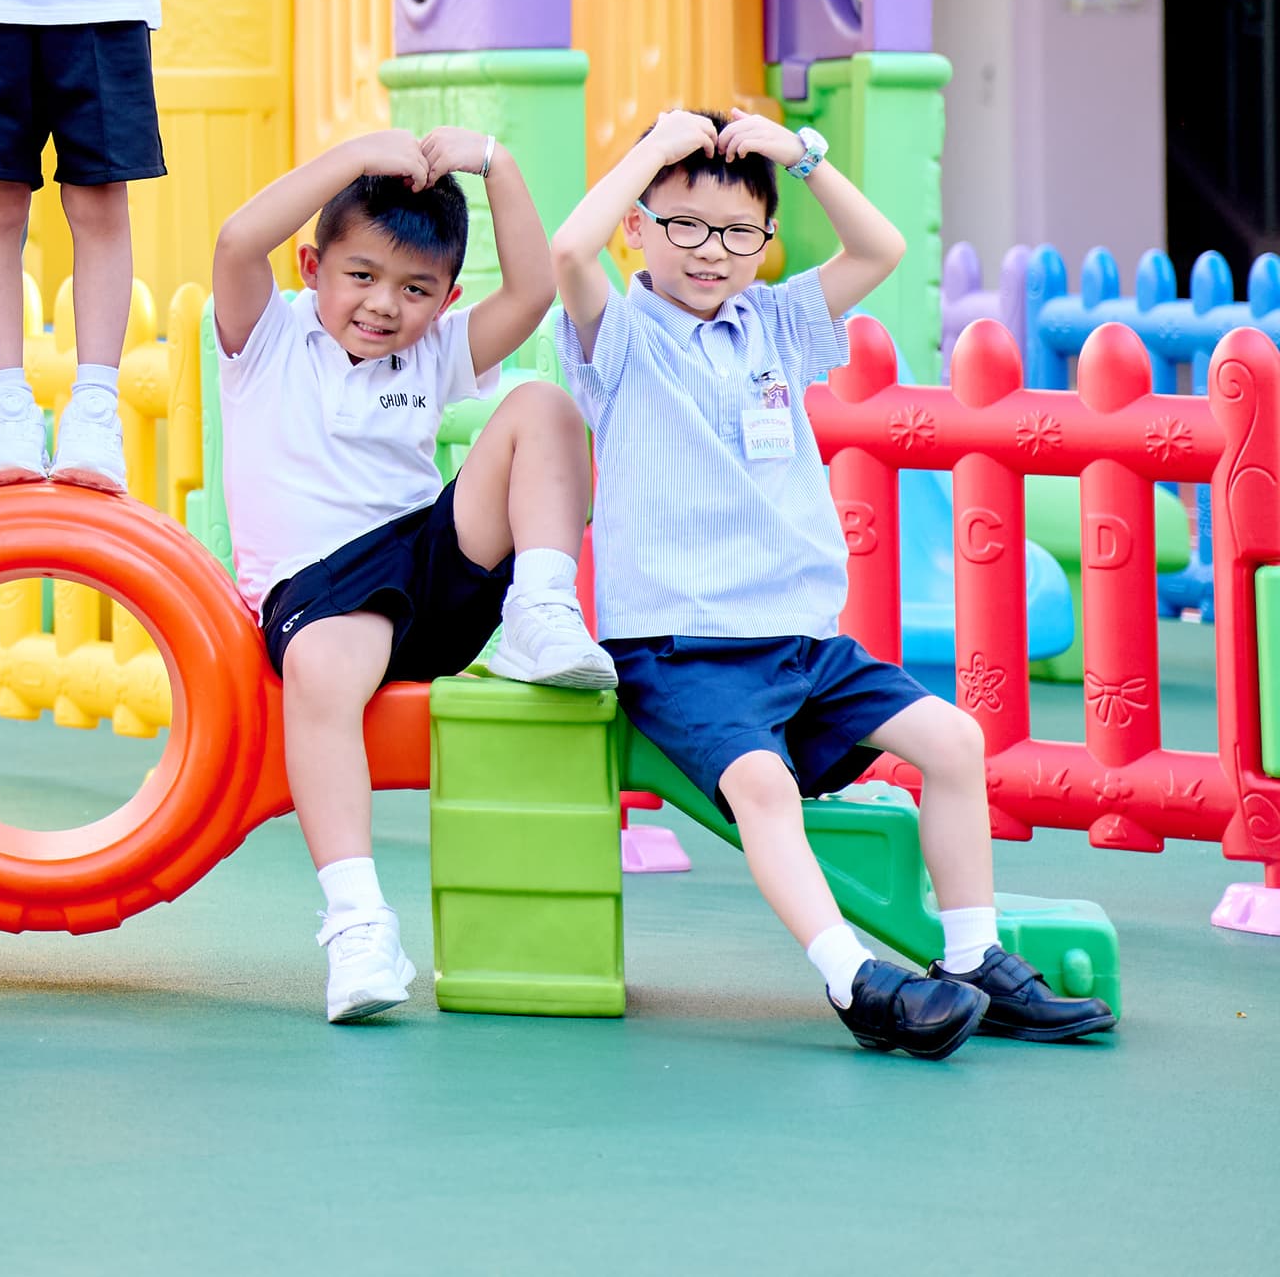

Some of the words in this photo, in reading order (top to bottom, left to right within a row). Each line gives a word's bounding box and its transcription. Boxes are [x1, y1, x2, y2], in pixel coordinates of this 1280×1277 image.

[379, 392, 408, 409] CHUN
[835, 500, 878, 556] B
[958, 507, 1005, 564] C
[1086, 512, 1132, 569] D
